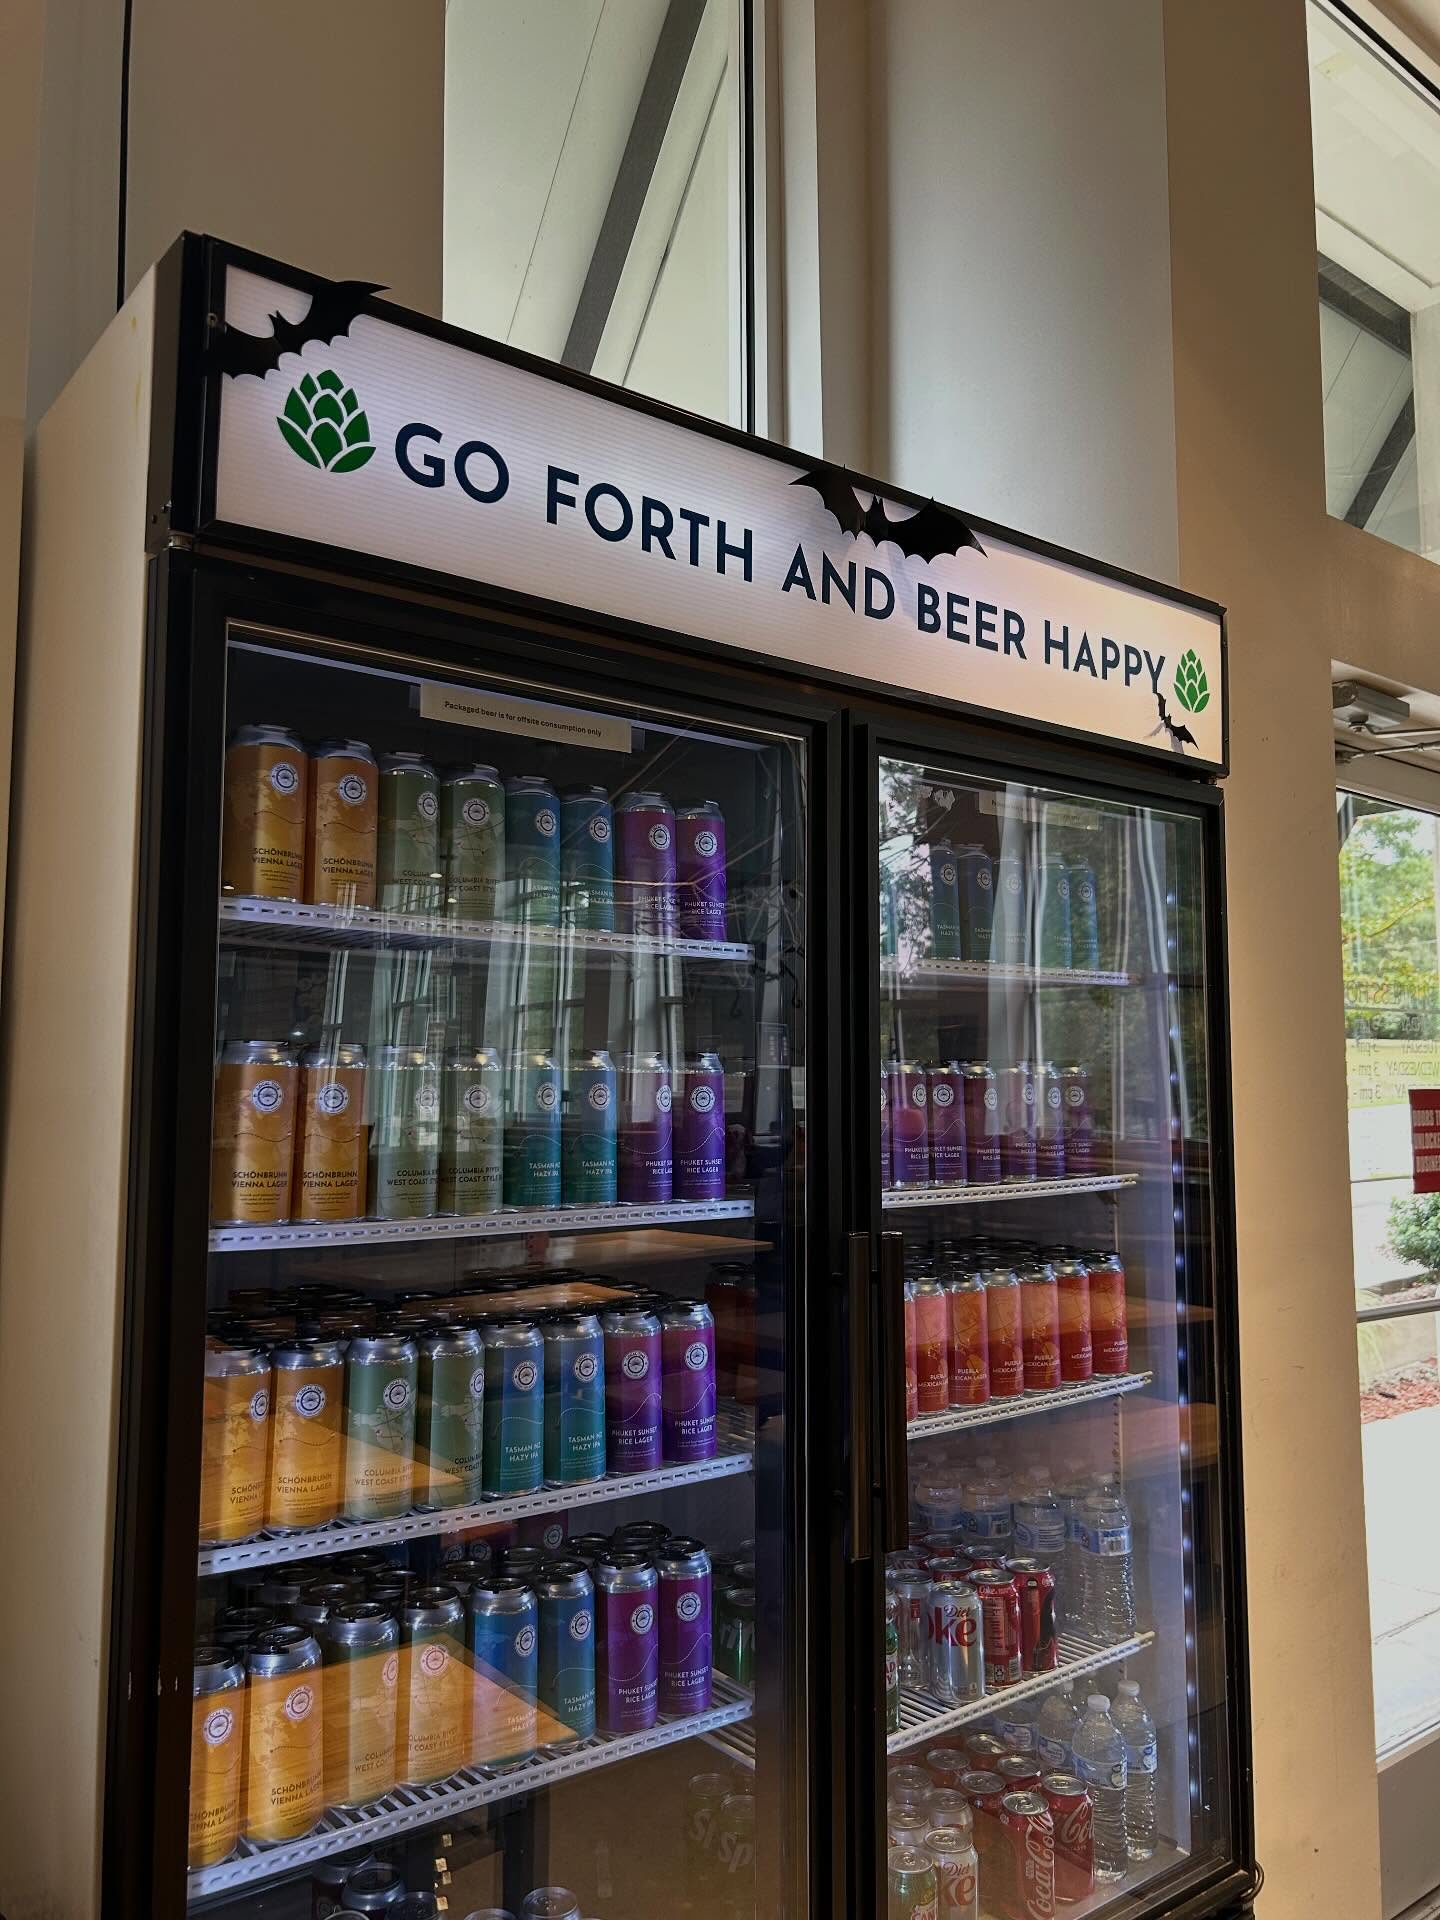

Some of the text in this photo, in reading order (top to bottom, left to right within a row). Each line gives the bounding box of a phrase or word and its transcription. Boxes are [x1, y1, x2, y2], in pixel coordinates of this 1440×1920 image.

[395, 423, 1166, 694] GO FORTH AND BEER HAPPY
[444, 700, 602, 738] Packaged beer is for offsite consumption only
[252, 856, 284, 866] VIENNA
[322, 866, 354, 875] VIENNA
[638, 894, 661, 902] PHUKET
[582, 1160, 608, 1168] TASMAN
[705, 1158, 722, 1166] SUNSET
[231, 1180, 288, 1188] VIENNA LAGER
[303, 1179, 358, 1188] VIENNA LAGER
[386, 1178, 405, 1186] WEST
[459, 1175, 481, 1183] COAST
[957, 1367, 980, 1375] PUEBLA
[674, 1419, 699, 1427] PHUKET
[612, 1425, 658, 1437] PHUKET SUNSET
[681, 1424, 713, 1435] RICE LAGER
[568, 1433, 595, 1444] TASMAN
[634, 1435, 653, 1445] LAGER
[505, 1441, 541, 1453] TASMAN NZ
[572, 1443, 591, 1451] HAZY
[509, 1450, 539, 1462] HAZY IPA
[354, 1478, 374, 1487] WEST
[375, 1477, 398, 1486] COAST
[277, 1485, 308, 1494] VIENNA
[943, 1605, 970, 1617] Diet
[928, 1606, 977, 1647] ke
[664, 1665, 709, 1679] PHUKET SUNSET
[687, 1676, 705, 1686] LAGER
[618, 1686, 643, 1695] PHUKET
[564, 1693, 589, 1705] TASMAN
[625, 1689, 656, 1704] RICE LAGER
[568, 1702, 586, 1713] HAZY
[414, 1741, 436, 1752] COAST
[355, 1761, 373, 1772] WEST
[271, 1792, 304, 1805] VIENNA
[943, 1861, 970, 1876] Diet
